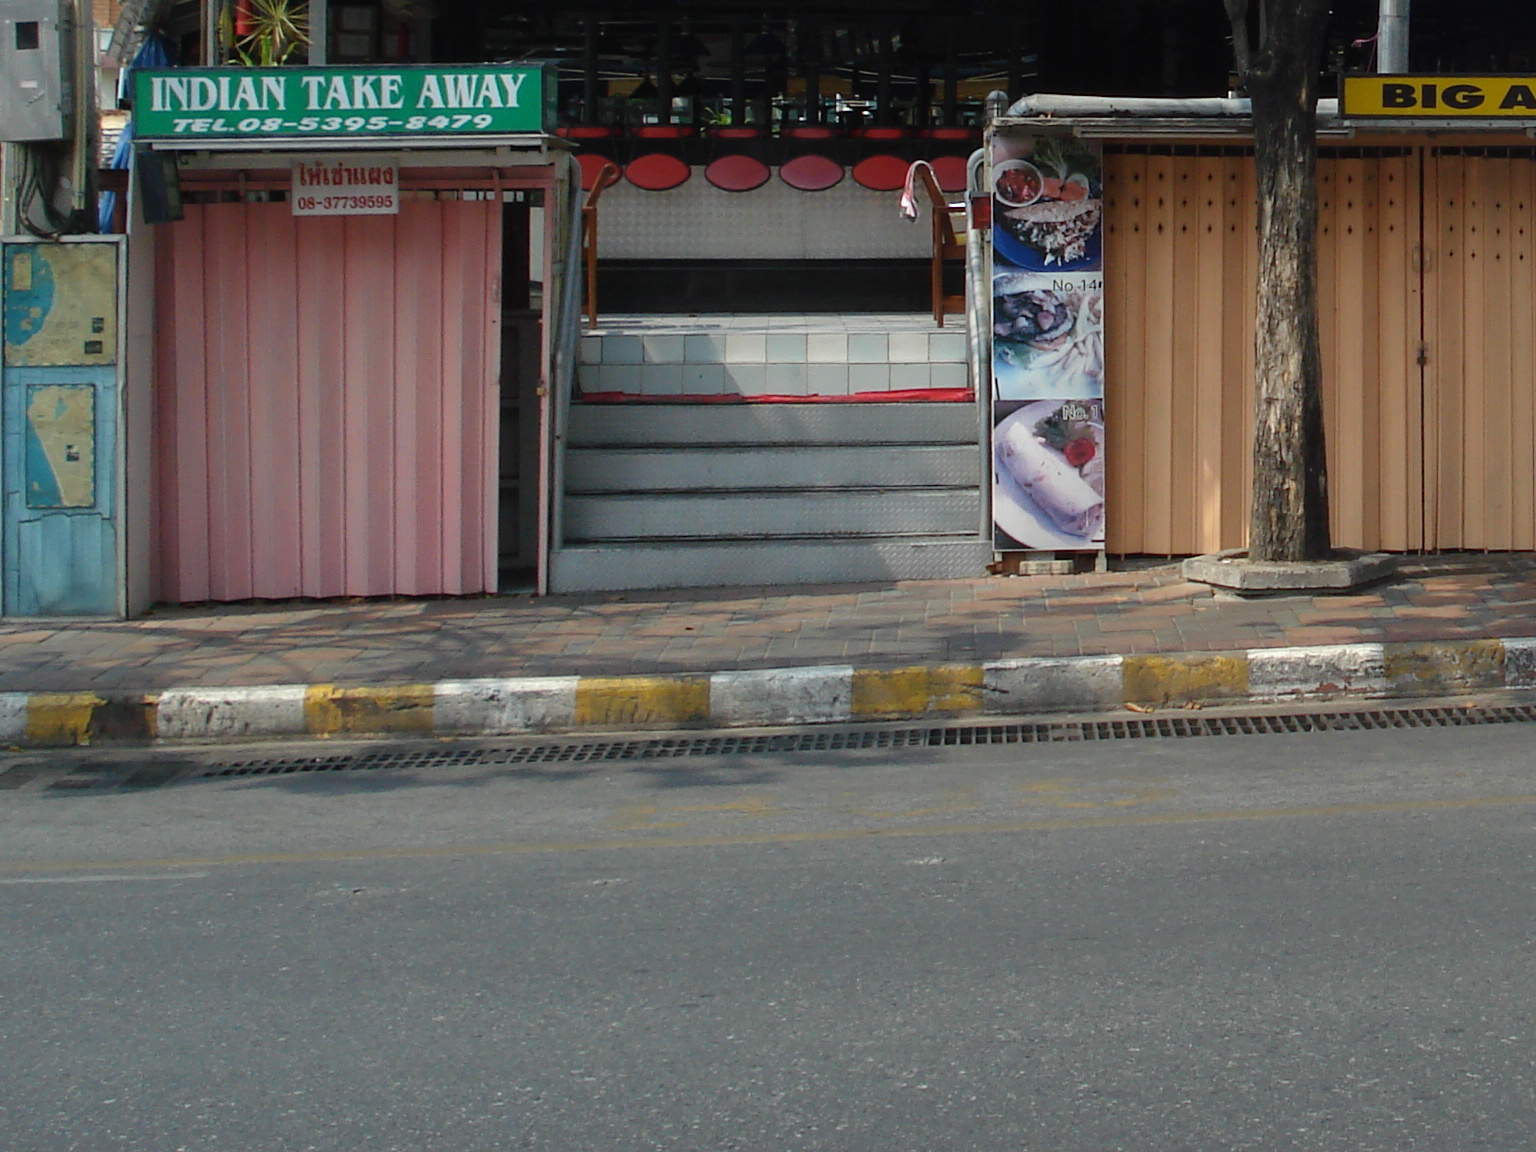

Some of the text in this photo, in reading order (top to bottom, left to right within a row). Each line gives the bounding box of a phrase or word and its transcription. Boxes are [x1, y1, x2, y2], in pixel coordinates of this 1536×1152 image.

[151, 73, 527, 112] INDIAN TAKE AWAY
[1381, 83, 1486, 110] BIG
[297, 195, 394, 210] 08-37739595
[1080, 279, 1097, 292] 14
